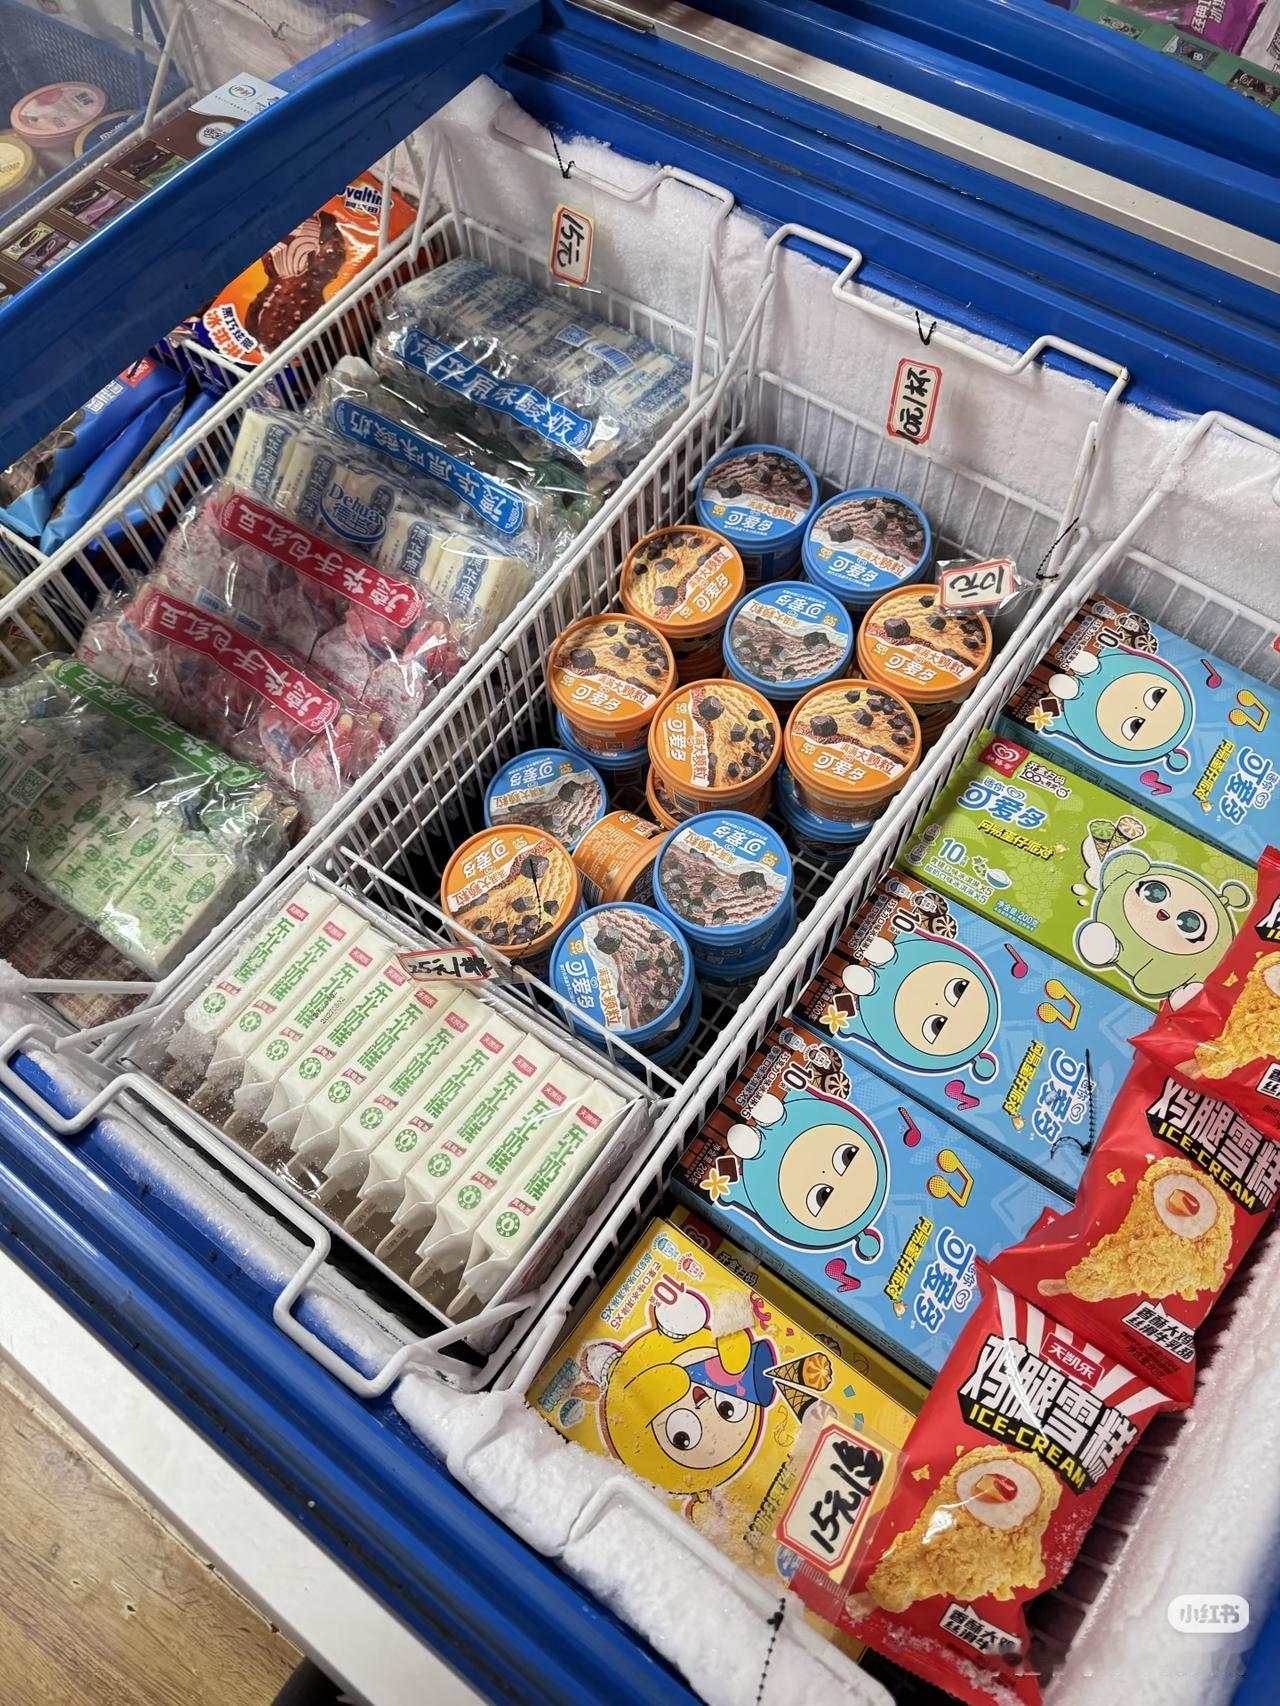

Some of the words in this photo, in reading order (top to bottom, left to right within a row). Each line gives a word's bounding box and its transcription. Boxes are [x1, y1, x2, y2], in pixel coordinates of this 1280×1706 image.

[724, 510, 774, 532] 可爱多
[238, 502, 412, 613] 德华手包红豆
[828, 555, 880, 583] 可爱多
[694, 572, 730, 613] 可爱多
[775, 592, 826, 620] 可爱多
[160, 601, 322, 718] 德华手包红豆
[884, 652, 938, 682] 可爱多
[571, 683, 622, 712] 可爱多
[510, 760, 554, 787] 可爱多
[665, 718, 687, 762] 可爱多
[813, 752, 867, 781] 可爱多
[957, 781, 1047, 830] 可爱多
[1219, 746, 1273, 825] 可爱多
[463, 838, 510, 879] 可爱多
[712, 825, 767, 857] 可爱多
[977, 820, 1054, 861] 网易蛋仔派对
[234, 916, 295, 984] 东北奶糕
[269, 936, 333, 1002] 东北奶糕
[294, 961, 360, 1030] 东北奶糕
[329, 980, 394, 1048] 东北奶糕
[565, 959, 595, 1010] 可爱多
[357, 1001, 423, 1072] 东北奶糕
[388, 1026, 457, 1098] 东北奶糕
[422, 1047, 490, 1120] 东北奶糕
[455, 1069, 524, 1145] 东北奶糕
[522, 1121, 589, 1201] 东北奶糕
[1157, 1120, 1257, 1210] ICE-CREAM
[883, 1216, 934, 1299] 网易蛋仔派对
[914, 1226, 976, 1333] 可爱多
[1047, 1342, 1097, 1380] 天凯乐
[958, 1334, 1139, 1483] 鸡腿雪糕
[969, 1403, 1088, 1489] ICE-CREAM
